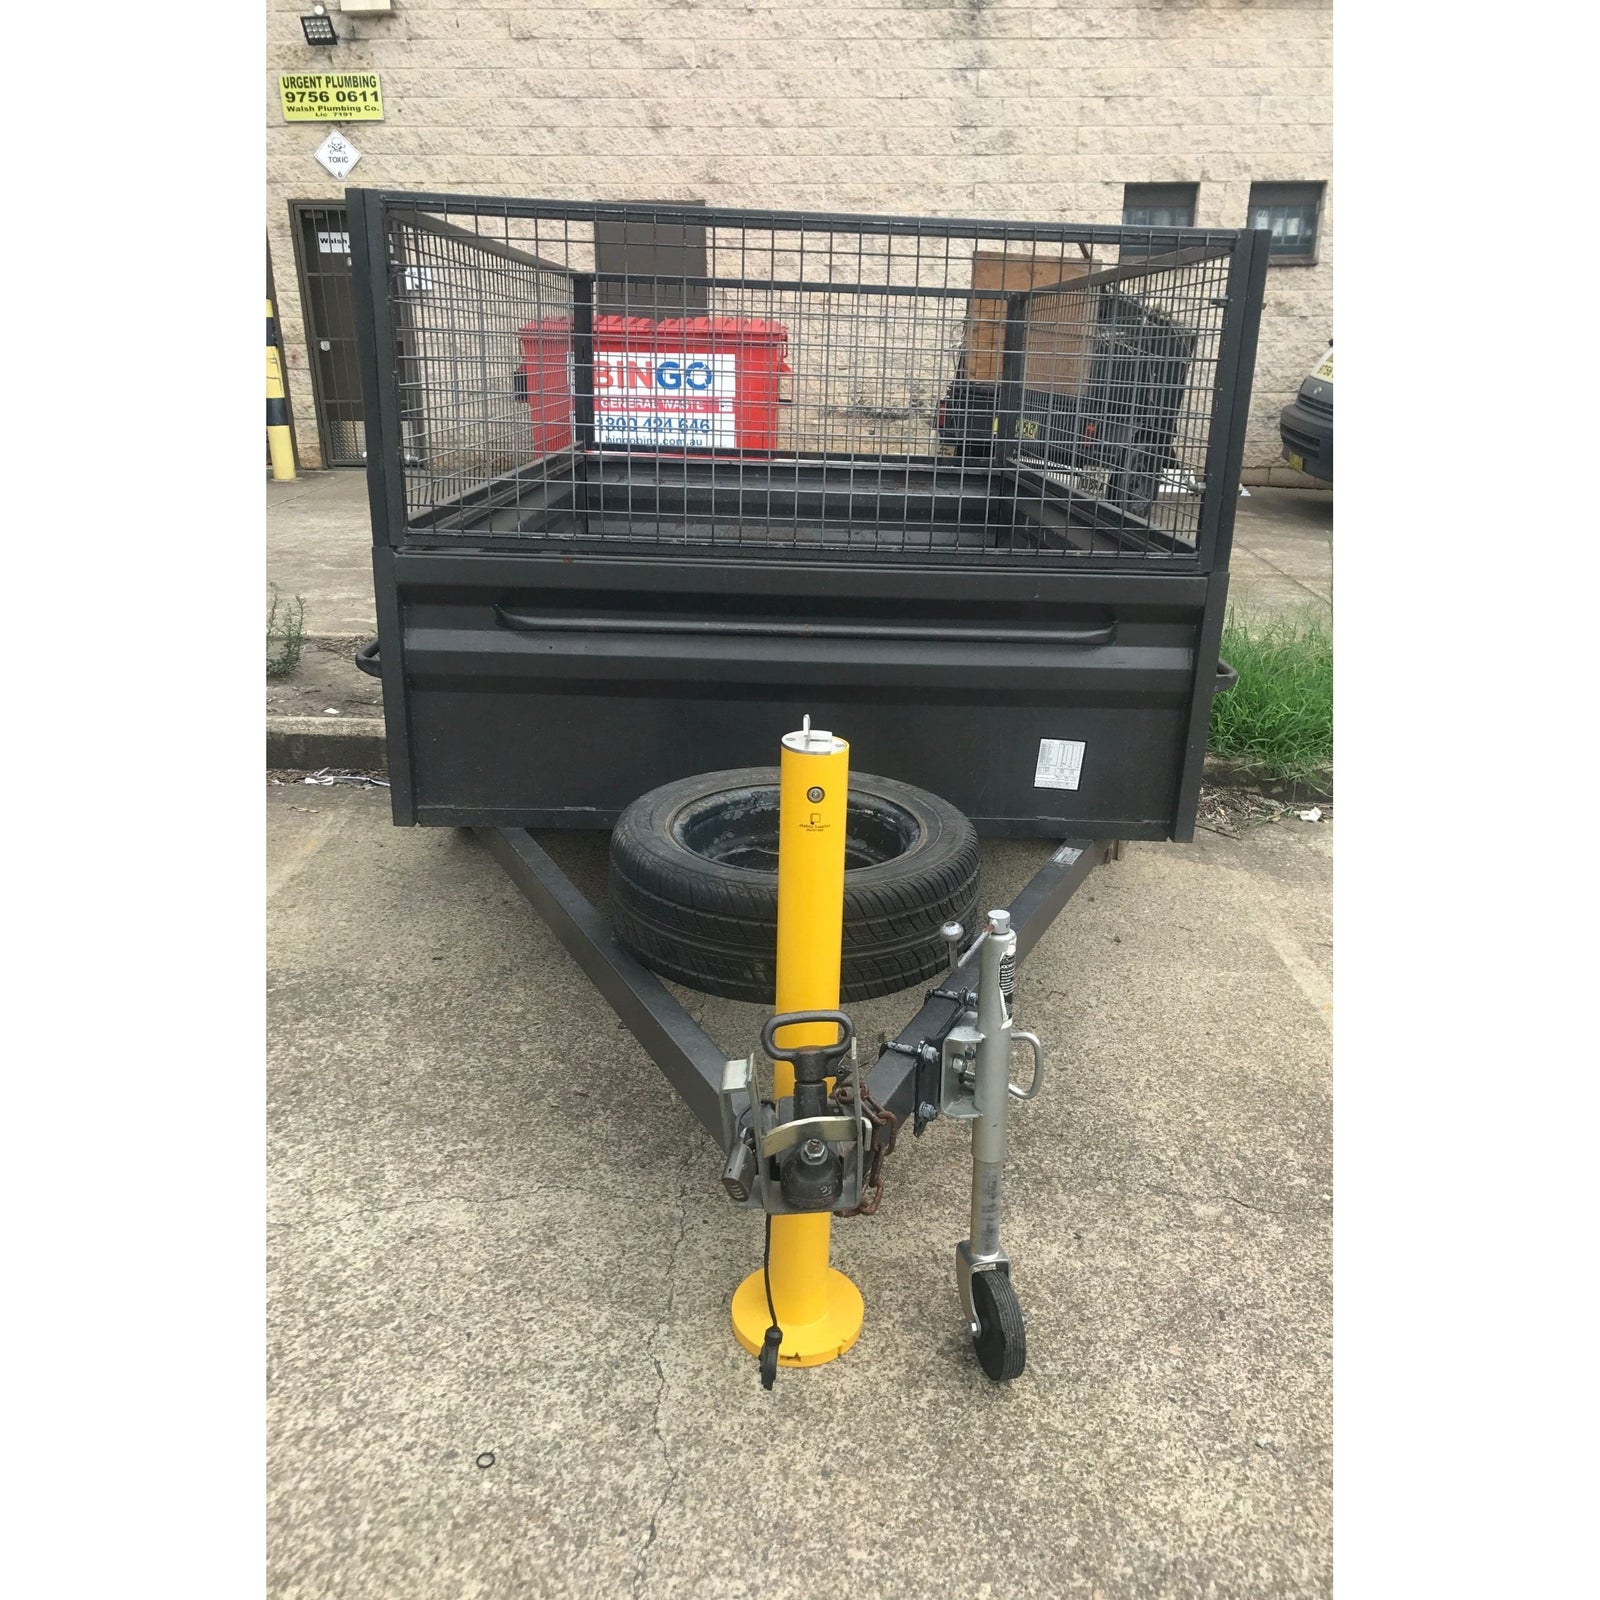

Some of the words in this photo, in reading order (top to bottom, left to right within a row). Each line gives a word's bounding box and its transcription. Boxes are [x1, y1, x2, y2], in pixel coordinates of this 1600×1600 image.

[282, 76, 322, 89] URGENT
[325, 75, 377, 88] PLUMBING
[284, 91, 330, 103] 9756
[335, 90, 379, 102] 0611
[317, 105, 361, 113] Plumbing
[593, 360, 713, 391] BINGO
[600, 397, 659, 410] GENERAL
[661, 398, 704, 411] WASTE
[596, 417, 638, 432] 1300
[643, 417, 673, 433] 424
[677, 418, 710, 434] 646
